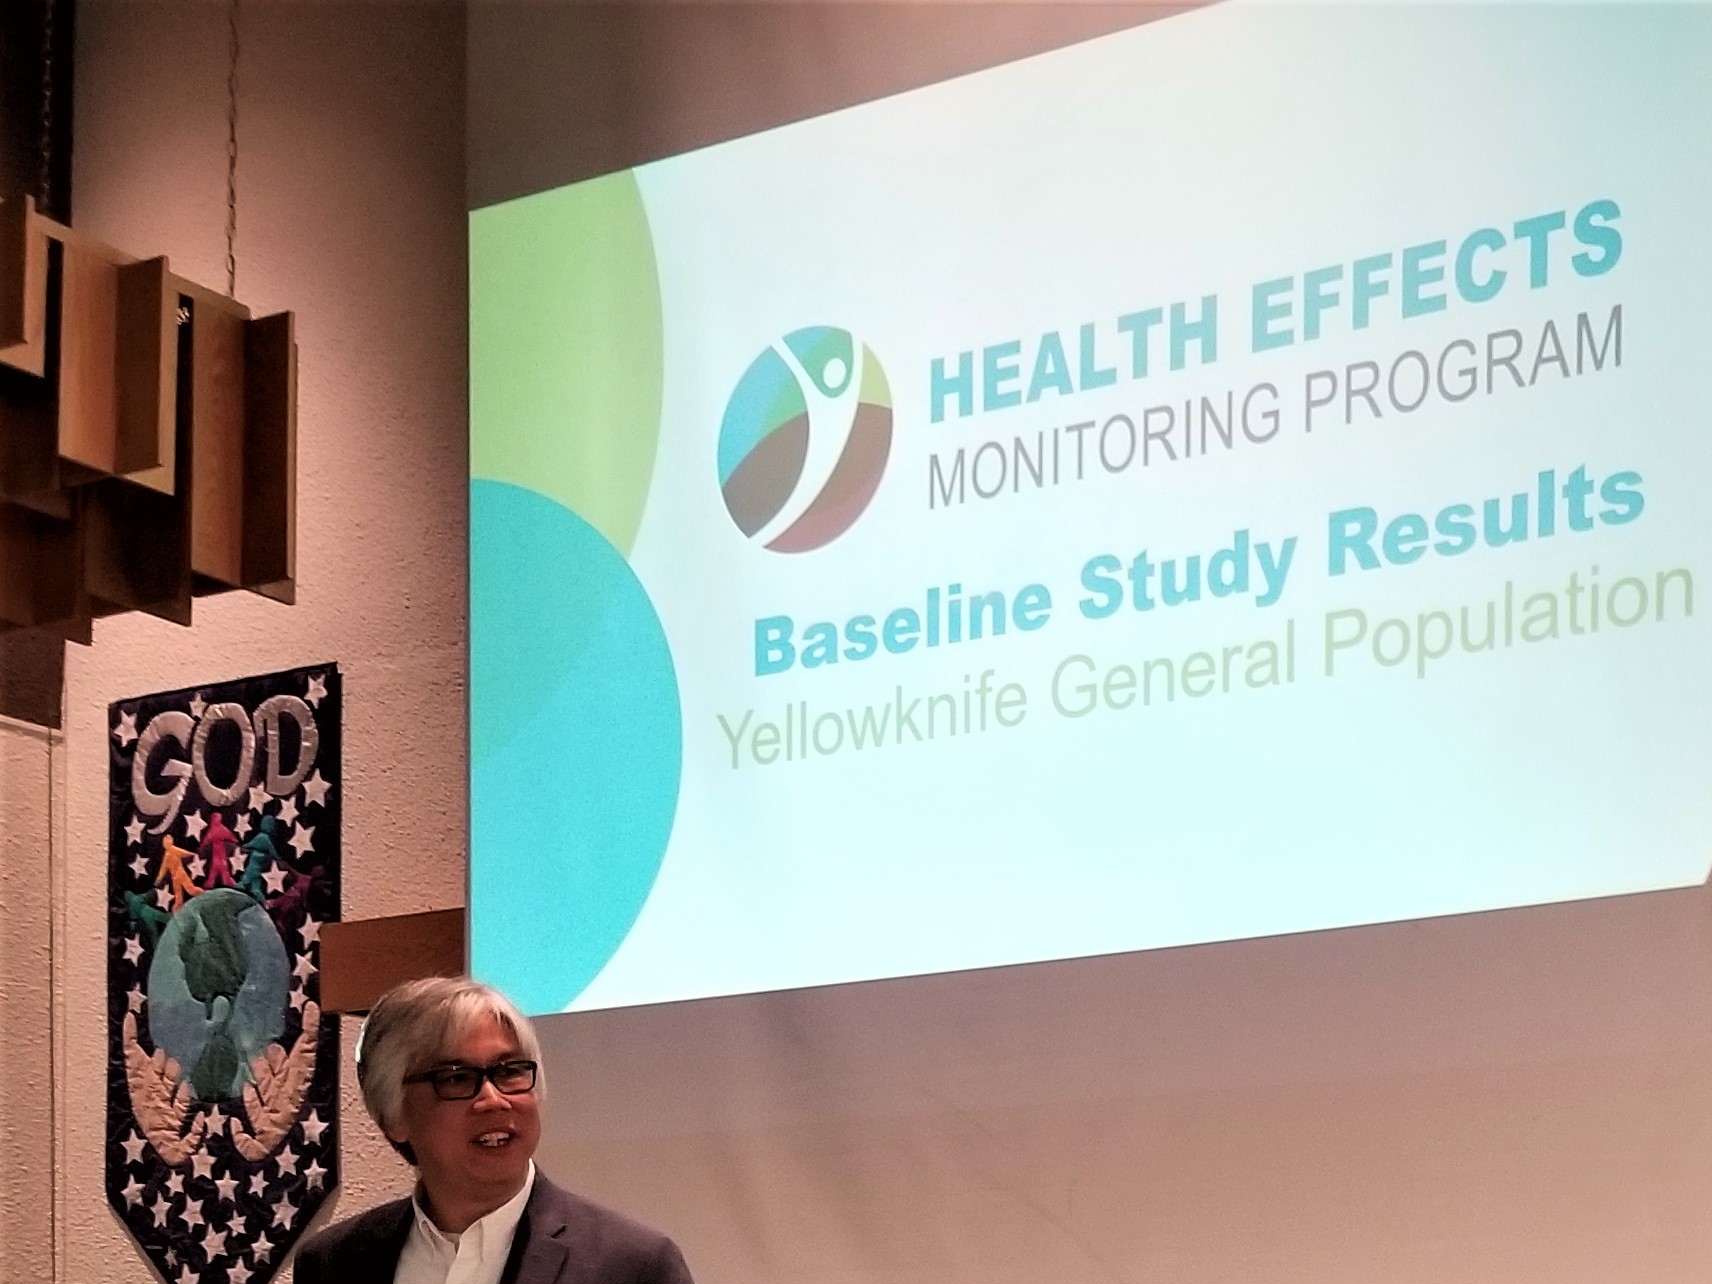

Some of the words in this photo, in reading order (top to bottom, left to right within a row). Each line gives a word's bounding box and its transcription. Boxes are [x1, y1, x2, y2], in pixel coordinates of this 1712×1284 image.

[928, 382, 1281, 510] MONITORING
[1304, 304, 1624, 432] PROGRAM
[930, 294, 1219, 424] HEALTH
[1251, 198, 1623, 353] EFFECTS
[716, 669, 1028, 771] Yellowknife
[1050, 618, 1296, 719] General
[1325, 563, 1697, 680] Population
[754, 584, 1052, 677] Baseline
[1079, 528, 1298, 621] Study
[1327, 462, 1647, 577] Results
[131, 695, 320, 835] GOD
